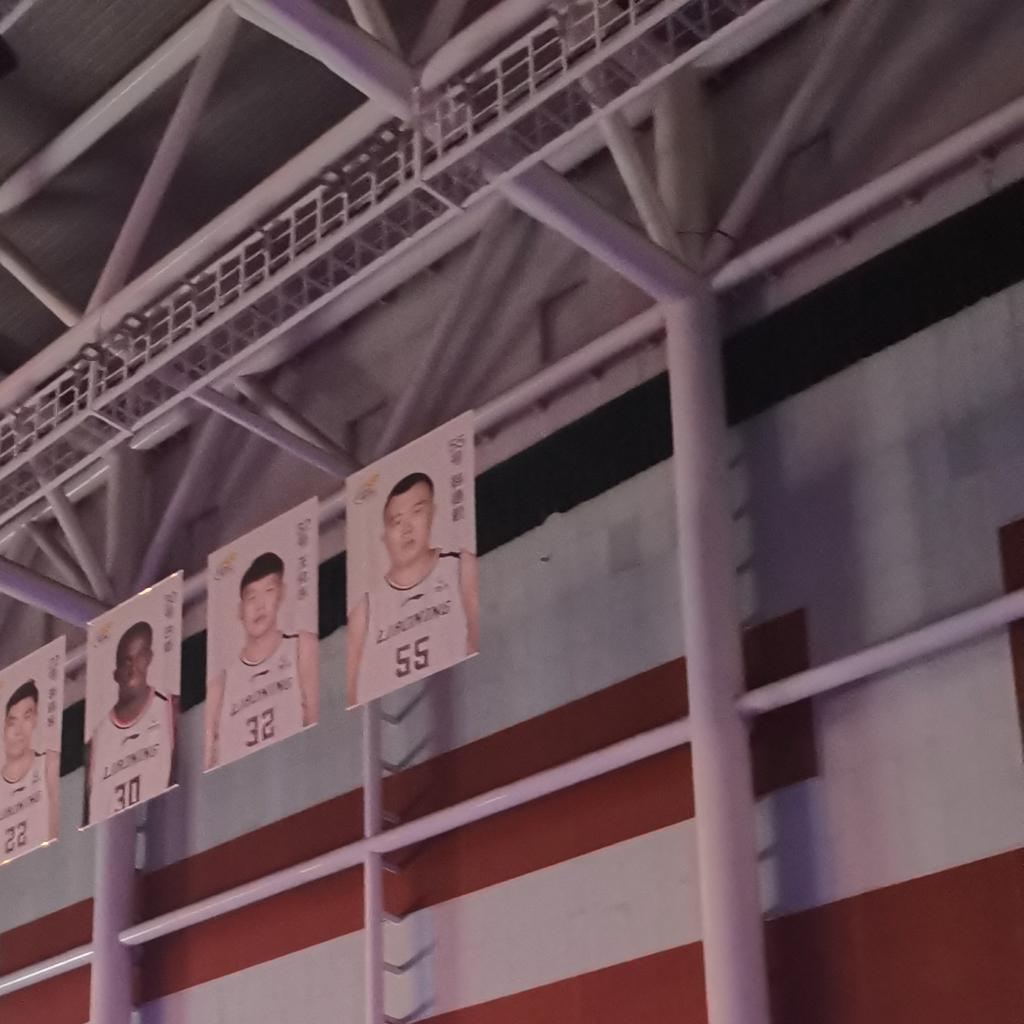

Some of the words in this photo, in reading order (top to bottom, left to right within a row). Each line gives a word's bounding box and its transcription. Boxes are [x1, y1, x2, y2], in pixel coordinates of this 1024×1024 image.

[396, 636, 430, 678] 55
[245, 707, 275, 748] 32
[114, 775, 141, 812] 30
[5, 820, 27, 854] 22
